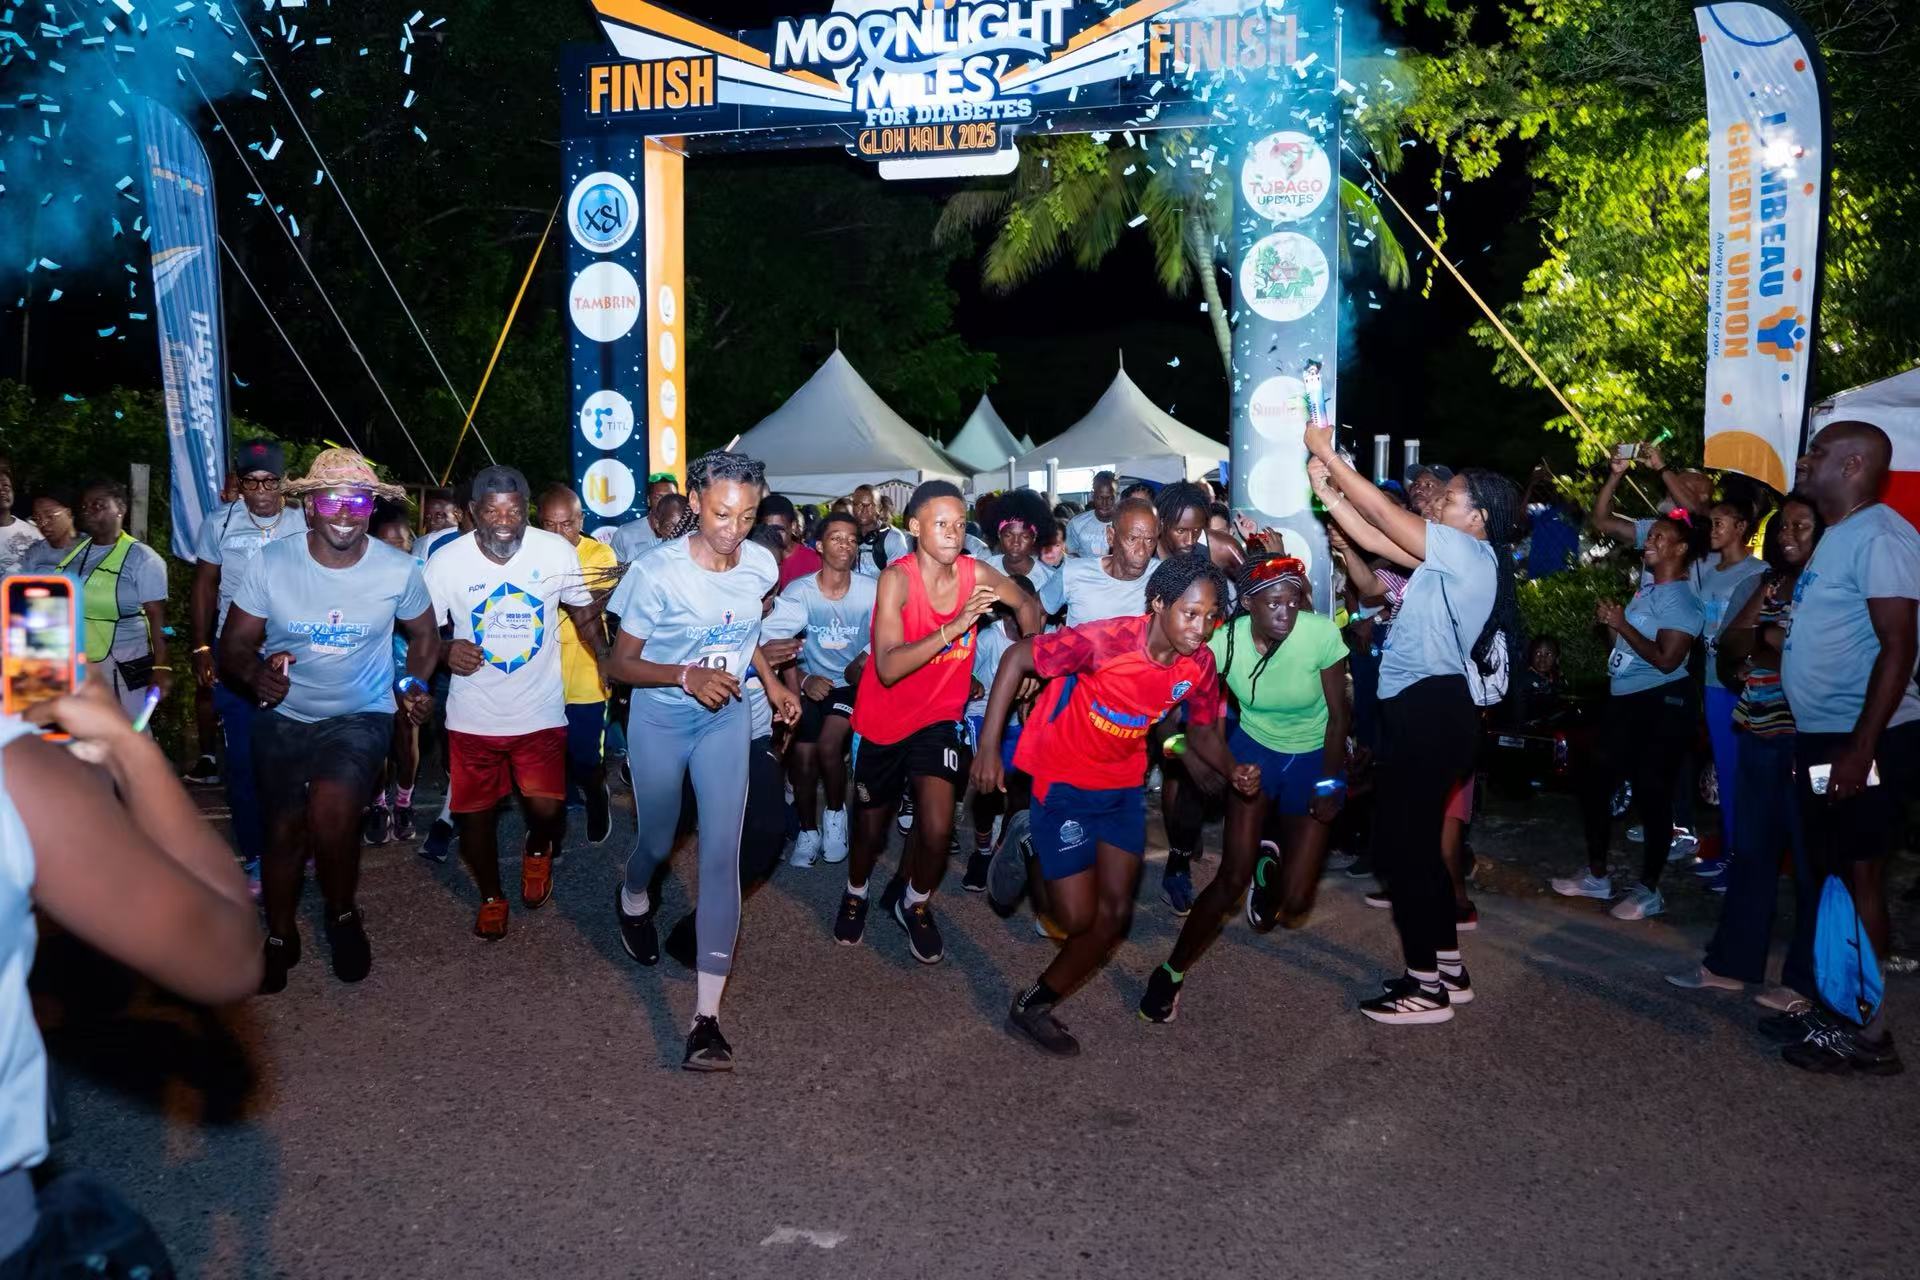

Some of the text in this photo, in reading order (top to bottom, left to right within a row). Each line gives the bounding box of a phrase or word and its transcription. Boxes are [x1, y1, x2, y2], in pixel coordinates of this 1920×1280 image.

[774, 0, 1071, 65] MOONLIGHT
[1150, 15, 1297, 75] FINISH
[591, 58, 713, 113] FINISH
[857, 57, 995, 110] MILES
[866, 99, 1032, 126] FOR DIABETES
[859, 122, 996, 155] GLOW WALK 2025
[1249, 179, 1323, 195] TOBAGO
[1257, 194, 1314, 206] UPDATES
[1727, 123, 1752, 245] CREDIT
[1758, 111, 1788, 299] LMBEAU
[1715, 232, 1725, 277] Always
[574, 295, 636, 310] TAMBRIN
[1715, 280, 1723, 304] here
[1723, 252, 1750, 359] UNION
[1714, 306, 1722, 324] for
[943, 747, 959, 772] 10
